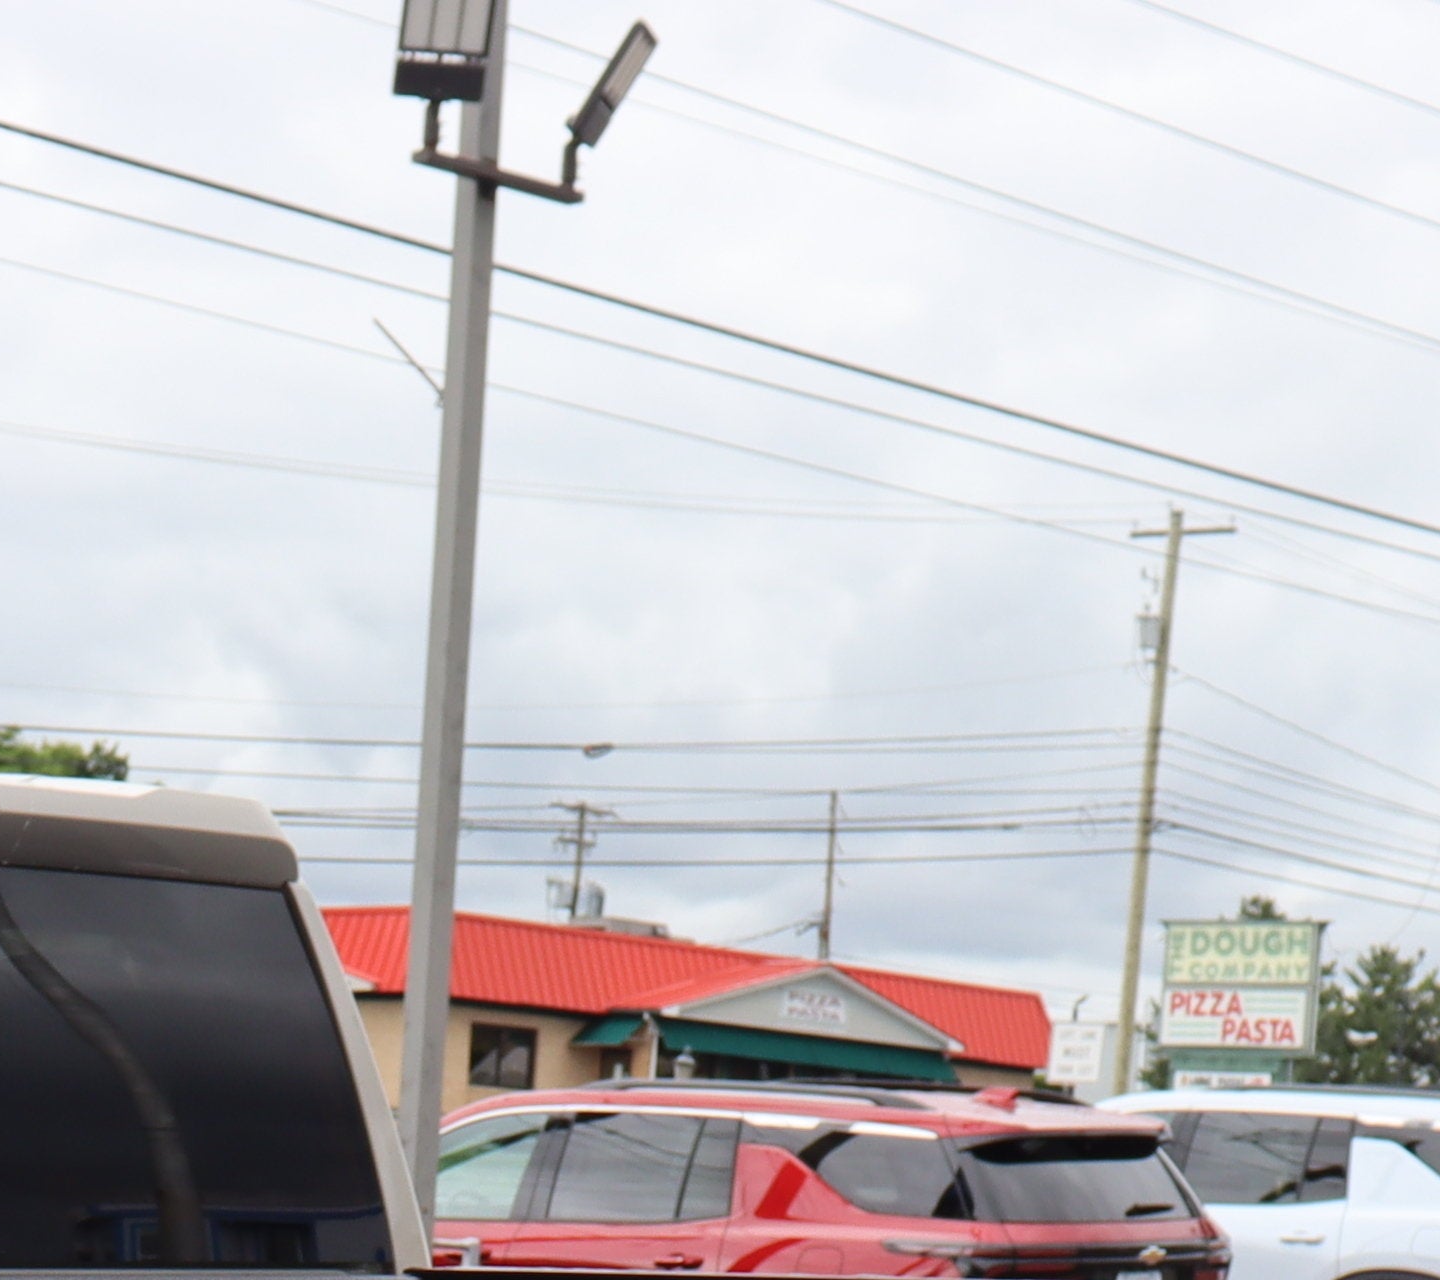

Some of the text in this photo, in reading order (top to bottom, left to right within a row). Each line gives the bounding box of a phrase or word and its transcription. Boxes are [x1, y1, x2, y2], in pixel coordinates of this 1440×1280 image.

[1190, 929, 1308, 957] DOUGH
[1188, 961, 1306, 979] COMPANY
[1170, 990, 1243, 1017] PIZZA
[1221, 1018, 1295, 1043] PASTA
